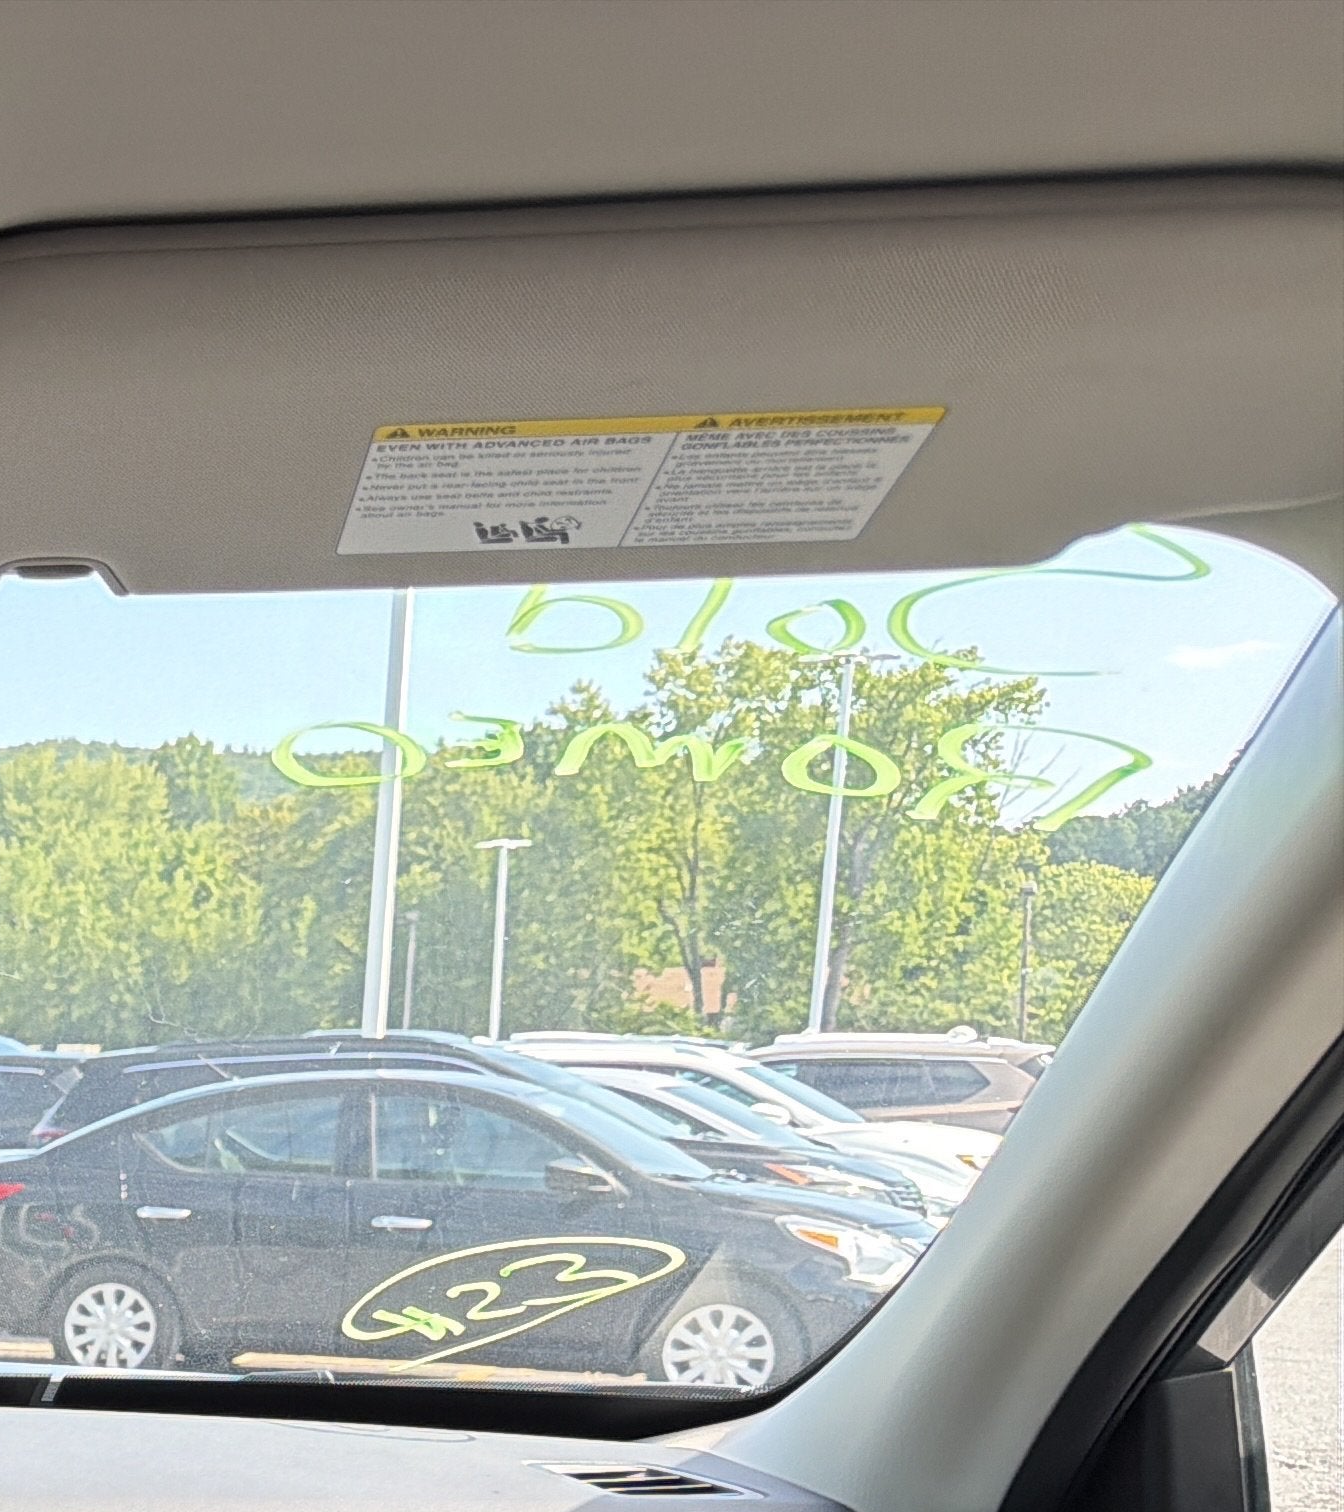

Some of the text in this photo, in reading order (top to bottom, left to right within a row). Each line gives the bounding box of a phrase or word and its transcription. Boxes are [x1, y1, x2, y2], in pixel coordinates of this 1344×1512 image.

[418, 425, 516, 437] WARNING
[376, 436, 652, 452] EVEN WITH ADVANCED AIR BAGS
